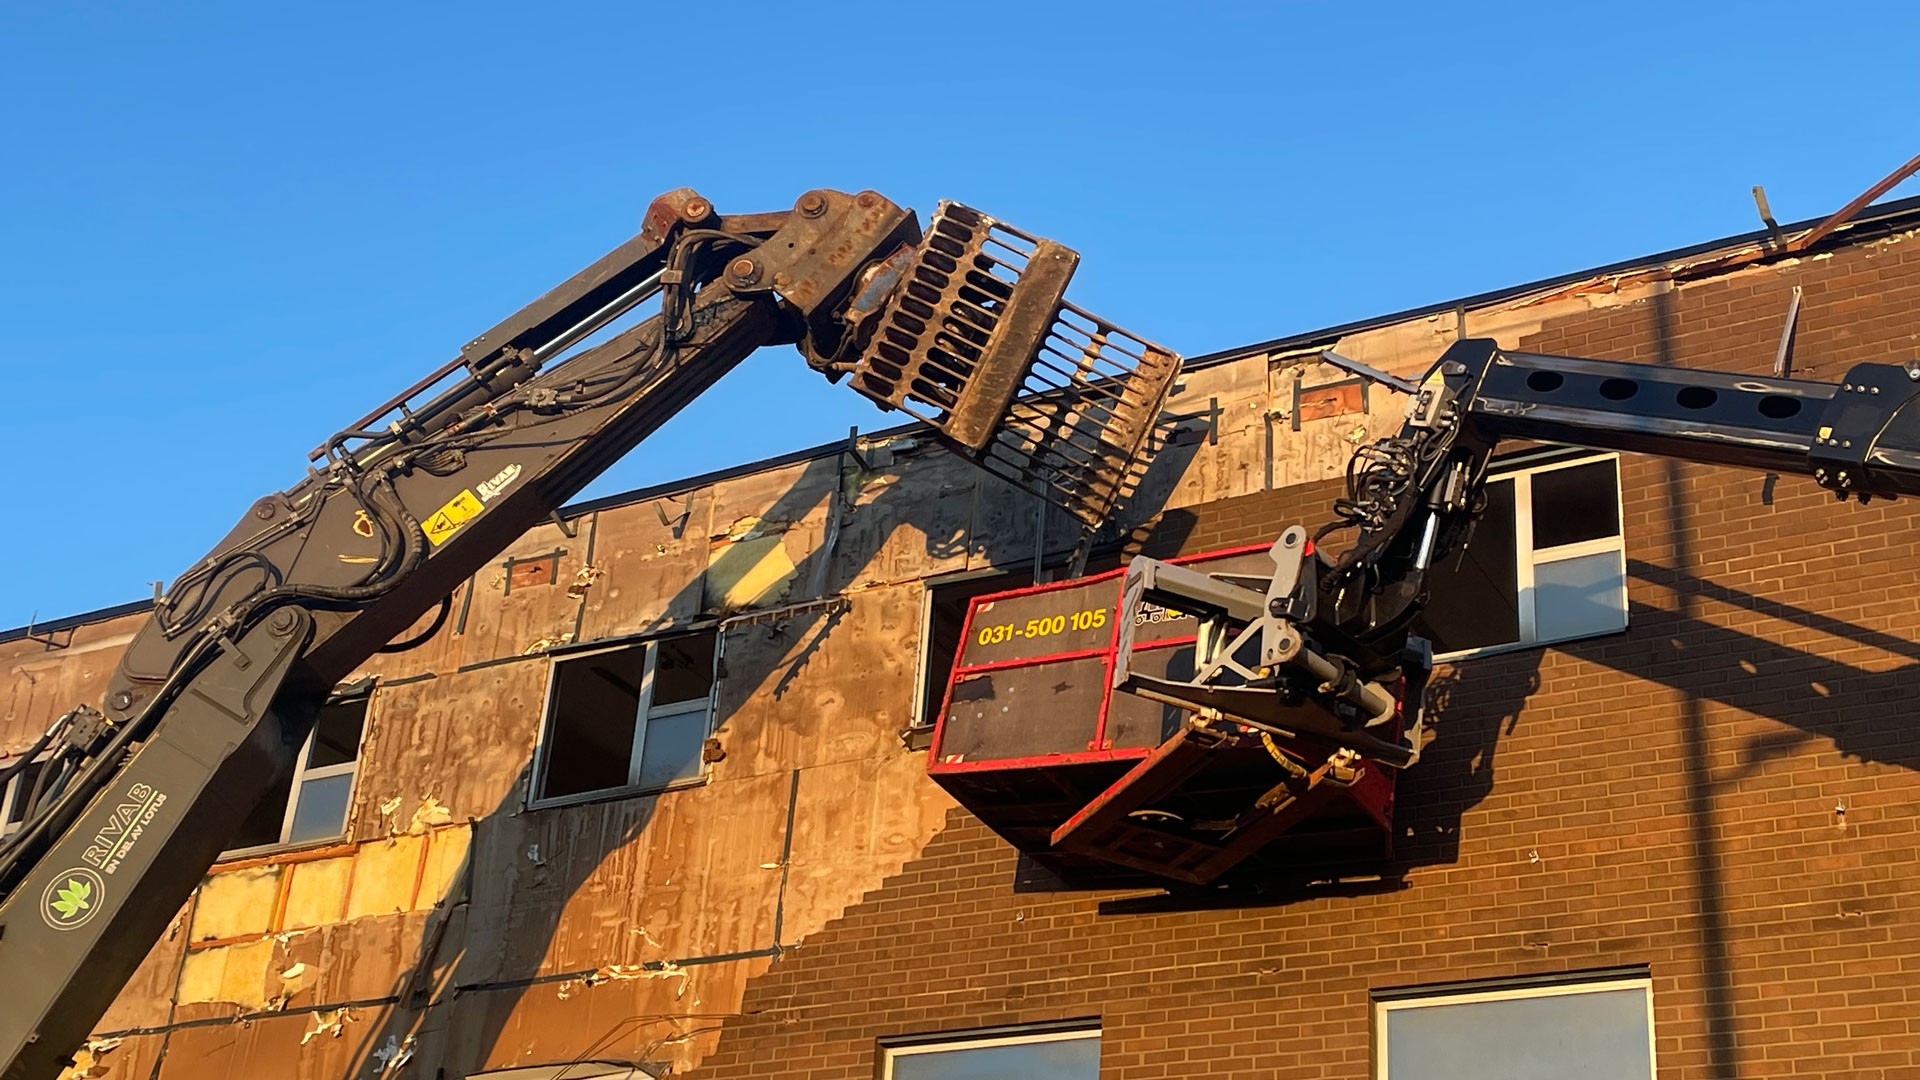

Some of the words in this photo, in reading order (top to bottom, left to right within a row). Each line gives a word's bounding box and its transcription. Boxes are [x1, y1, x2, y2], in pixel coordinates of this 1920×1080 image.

[979, 615, 1065, 645] 031-500
[1071, 609, 1106, 631] 105
[82, 783, 151, 866] RIVAB
[104, 859, 120, 875] EN
[116, 839, 135, 859] DEL
[132, 824, 143, 840] AV
[140, 793, 167, 825] LOTUS
